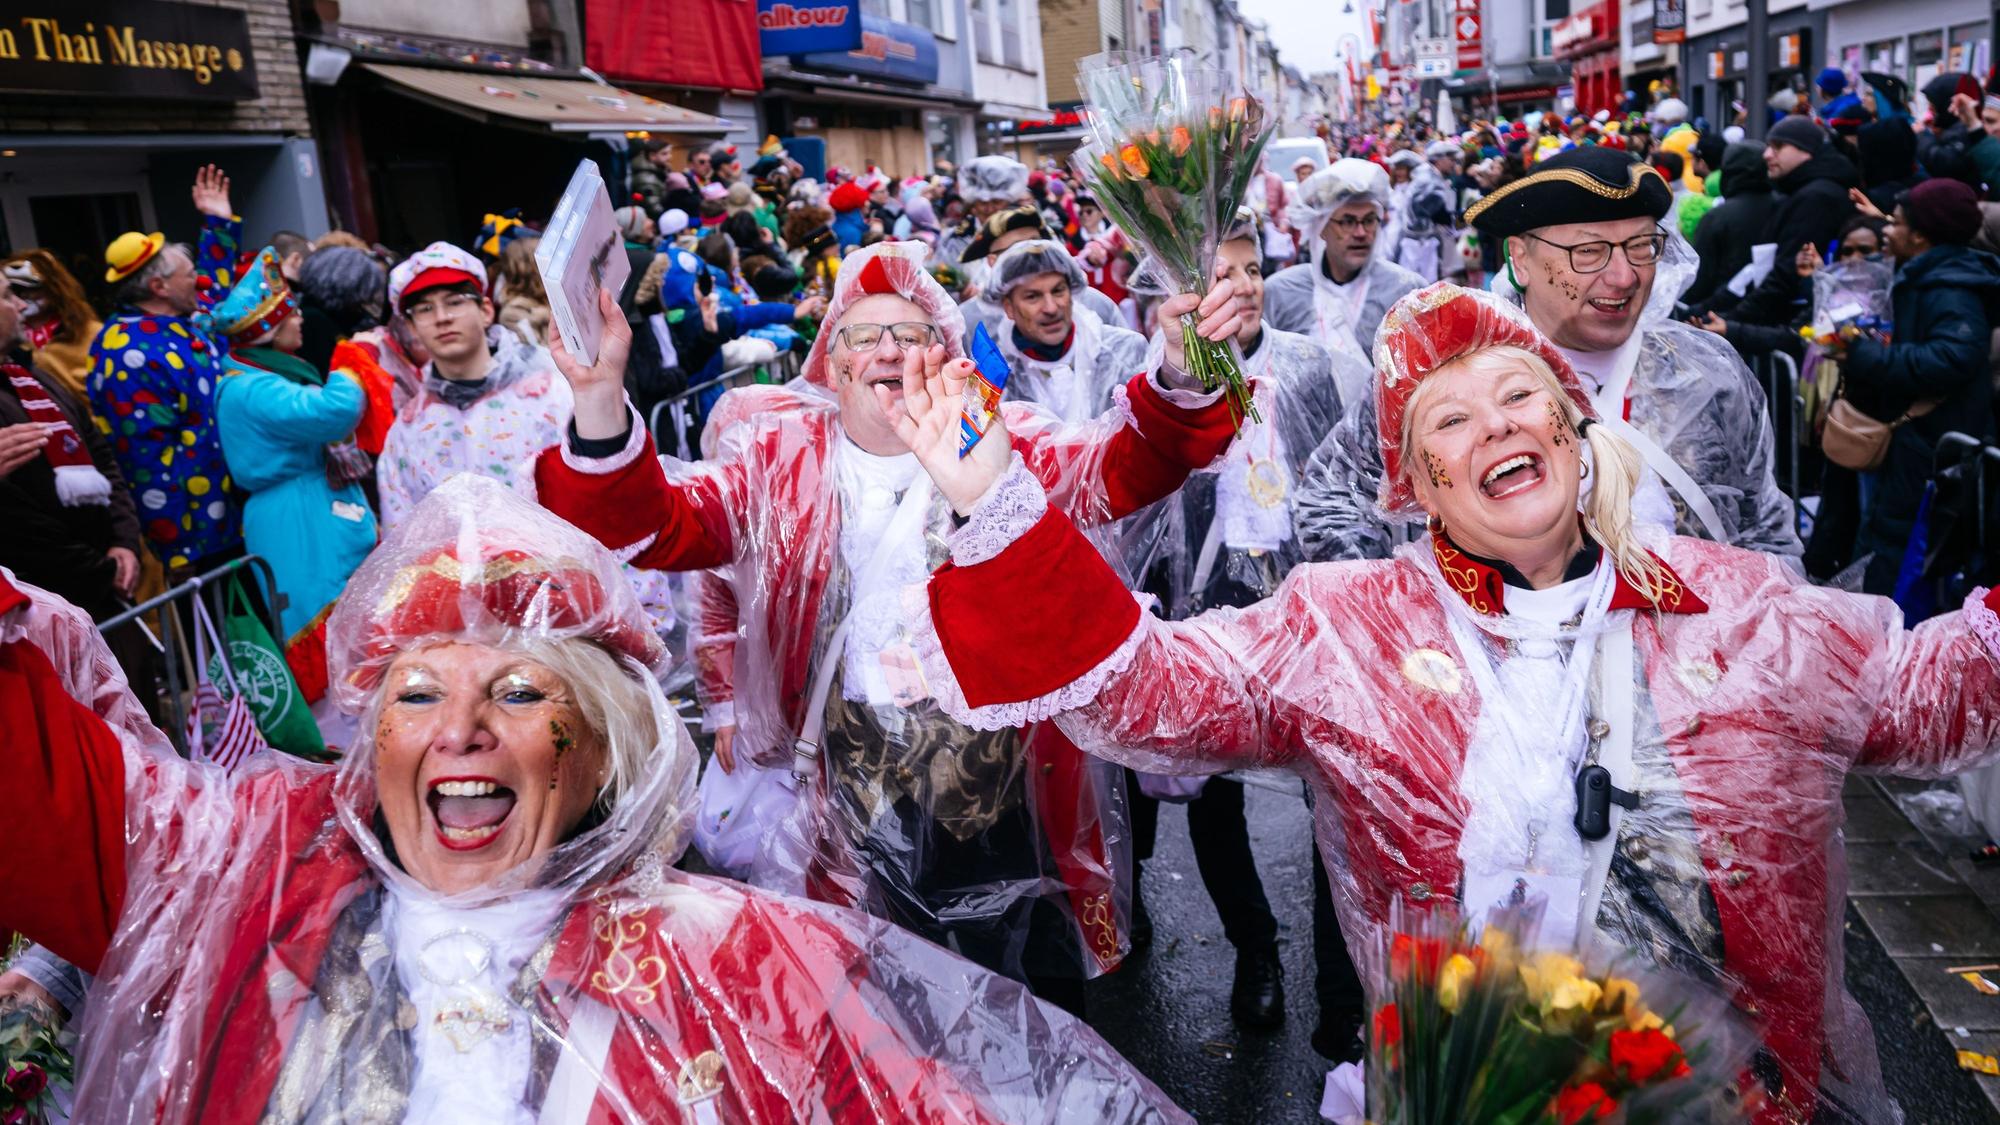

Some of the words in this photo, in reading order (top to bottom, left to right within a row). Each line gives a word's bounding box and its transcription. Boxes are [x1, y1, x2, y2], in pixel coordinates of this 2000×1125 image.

[759, 4, 848, 30] alltours
[21, 17, 103, 64] Thai
[104, 25, 222, 85] Massage
